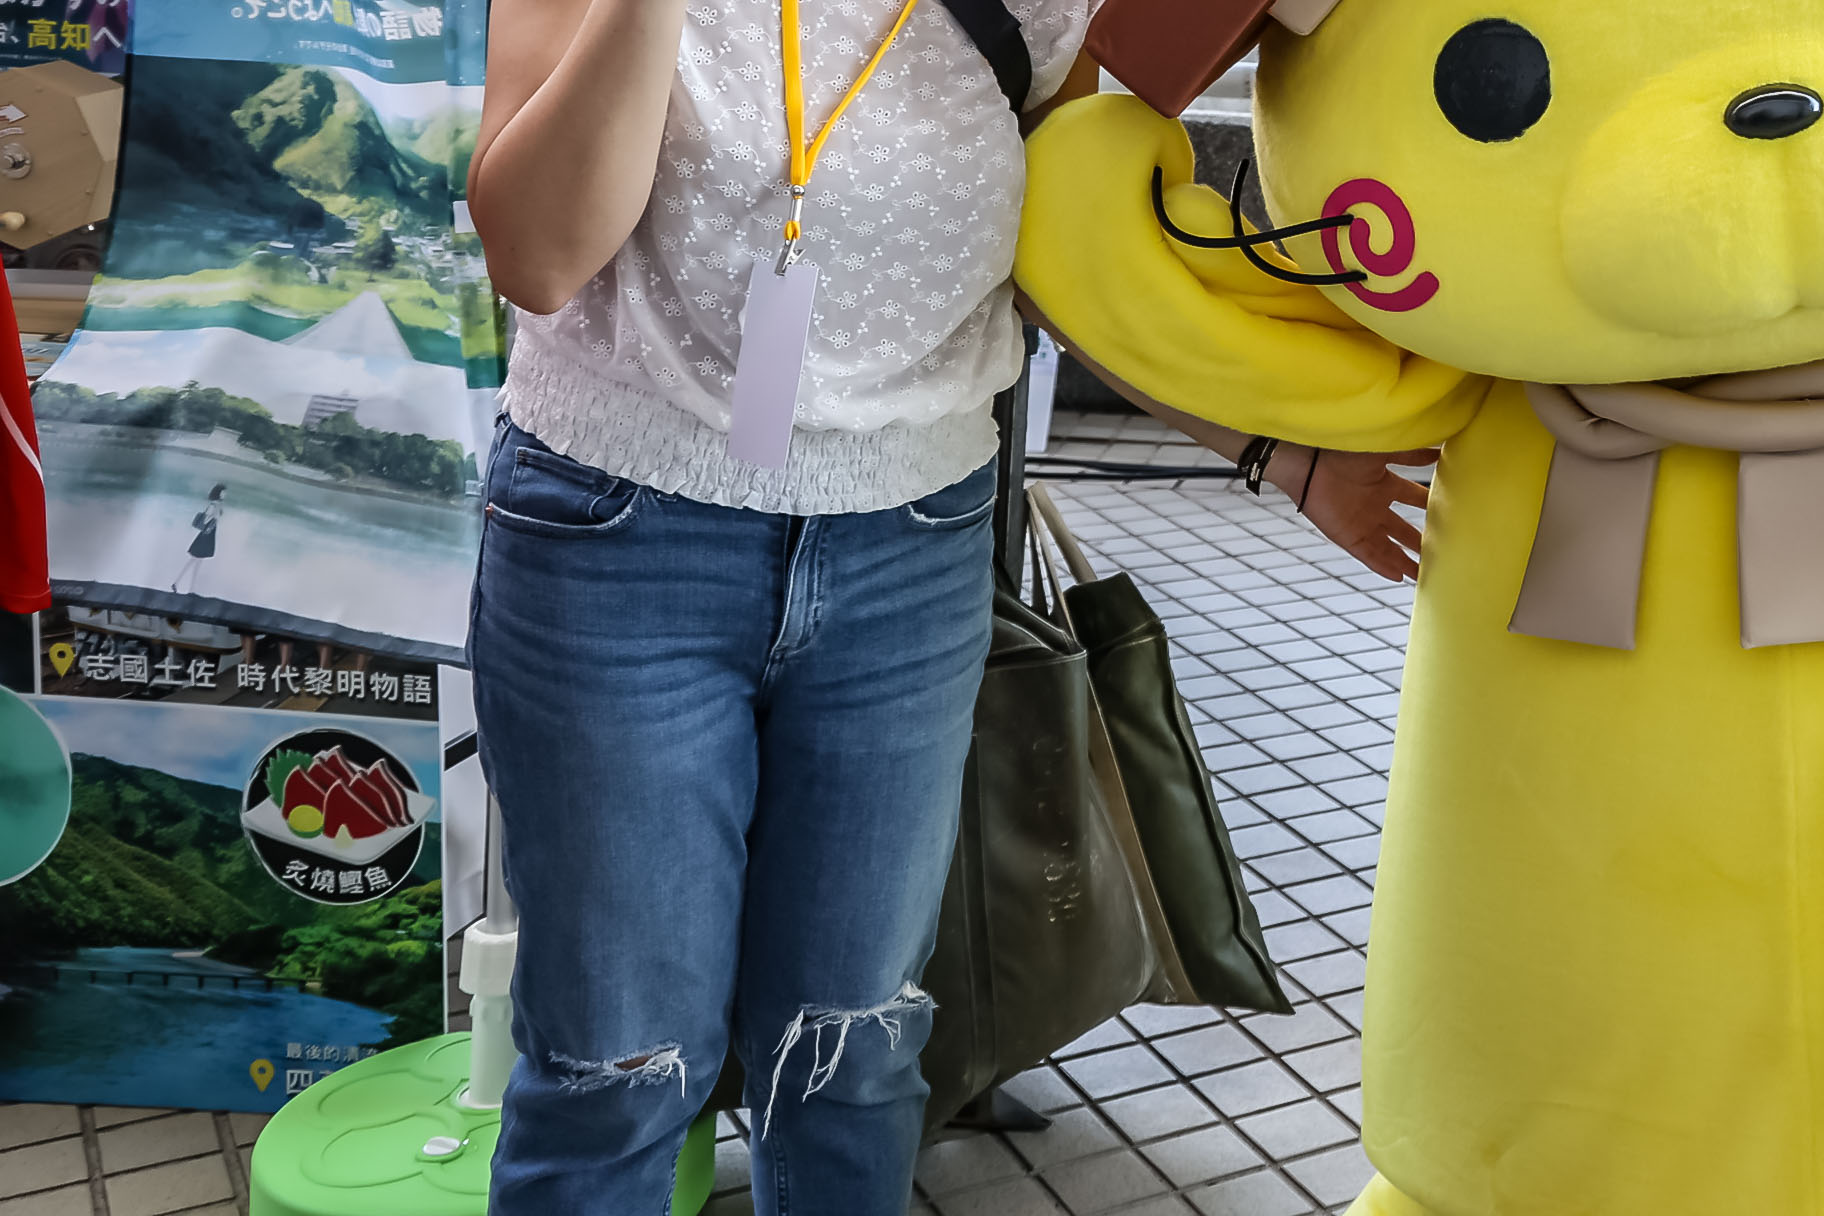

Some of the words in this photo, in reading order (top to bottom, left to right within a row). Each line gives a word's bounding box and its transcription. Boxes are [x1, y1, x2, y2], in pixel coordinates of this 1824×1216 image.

[84, 652, 217, 688] 志國土佐
[236, 662, 433, 706] 時代黎明物語
[281, 859, 393, 894] 炙燒鰹魚
